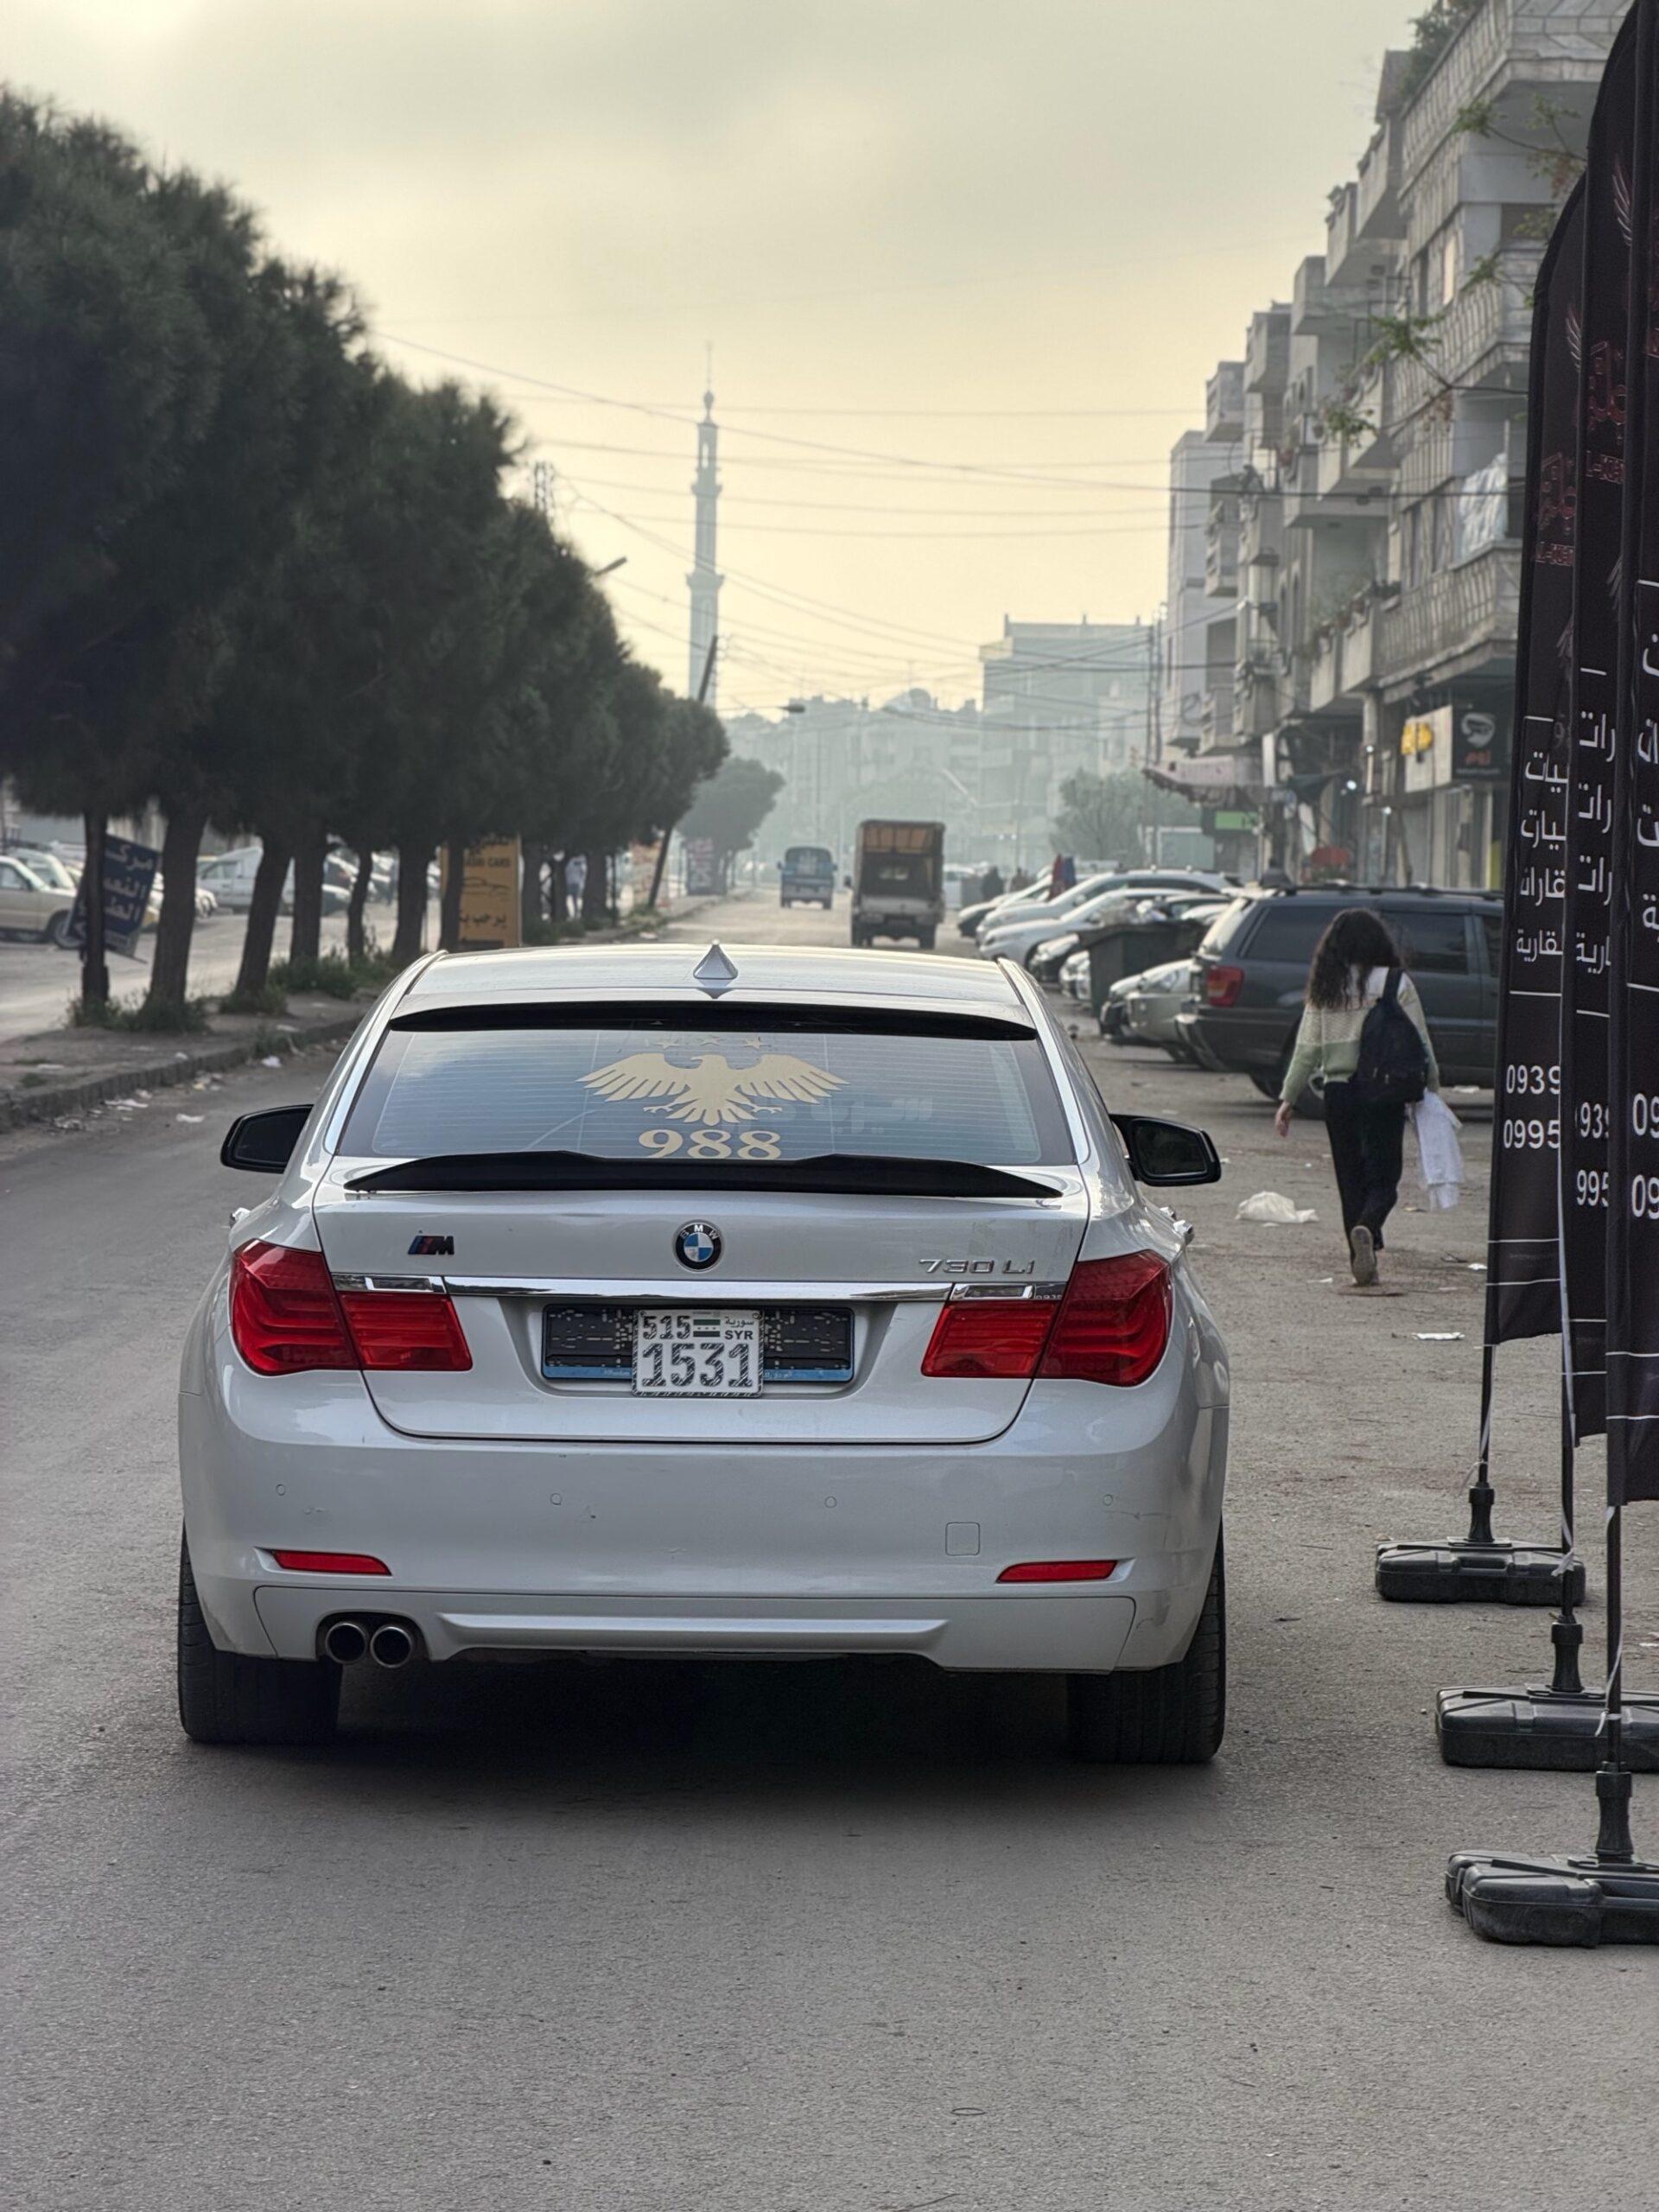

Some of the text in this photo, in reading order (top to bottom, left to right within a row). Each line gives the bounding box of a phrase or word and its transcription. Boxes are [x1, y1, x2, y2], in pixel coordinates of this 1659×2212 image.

[104, 843, 154, 871] مرك
[1505, 1064, 1560, 1095] 0939
[638, 1128, 782, 1160] 988
[1503, 1118, 1560, 1149] 0995
[679, 1224, 720, 1240] BMW
[643, 1315, 690, 1339] 515
[724, 1315, 754, 1328] سورية
[724, 1330, 754, 1340] SYR
[642, 1343, 753, 1387] 1531
